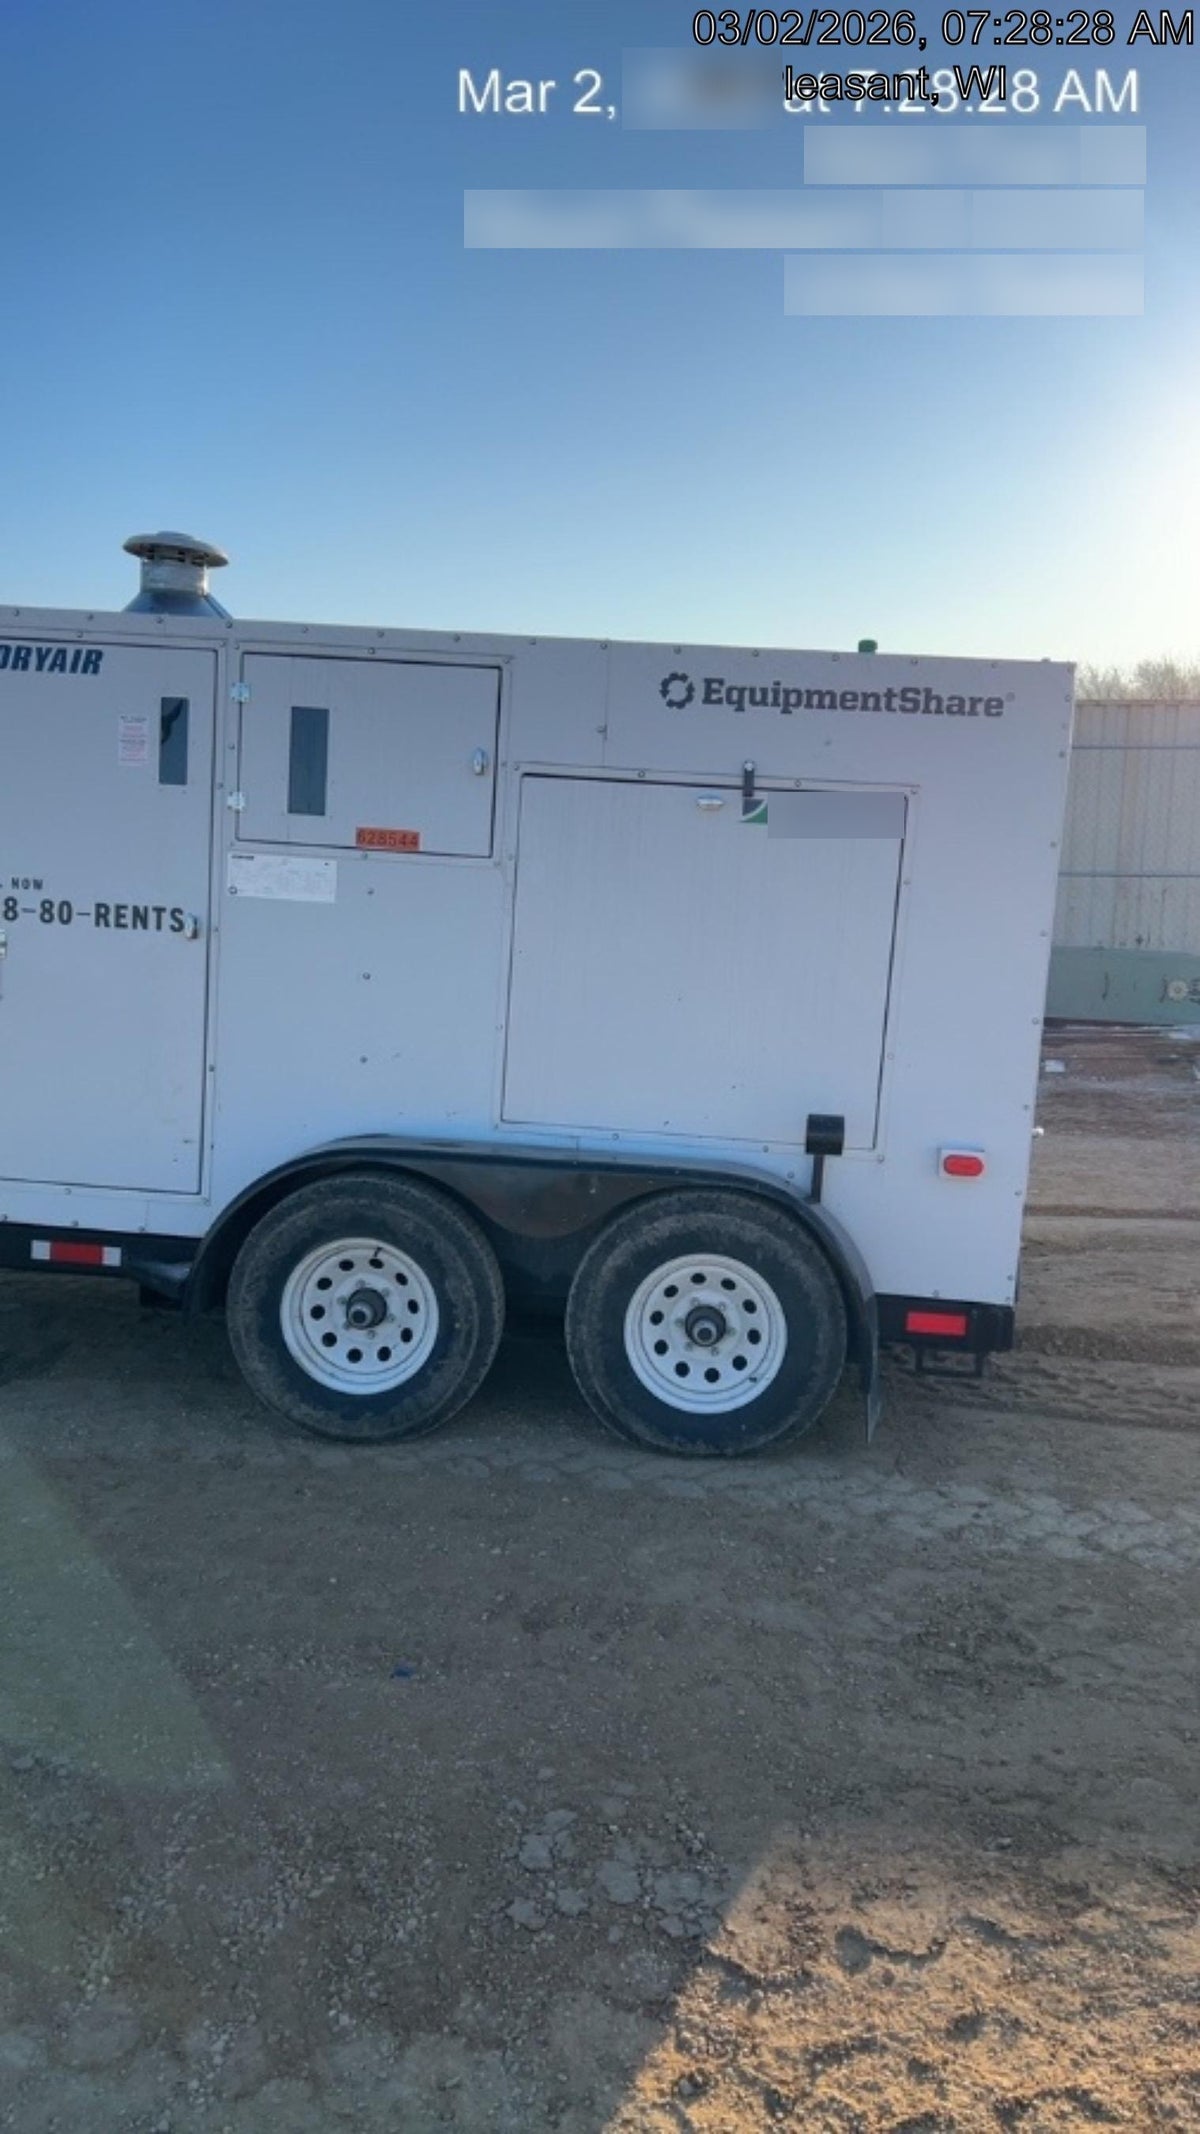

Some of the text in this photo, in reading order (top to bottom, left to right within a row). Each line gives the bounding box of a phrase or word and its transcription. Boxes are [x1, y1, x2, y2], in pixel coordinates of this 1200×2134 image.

[702, 677, 1005, 718] EquipmentShare
[357, 829, 420, 850] 628544
[11, 877, 44, 890] NOW
